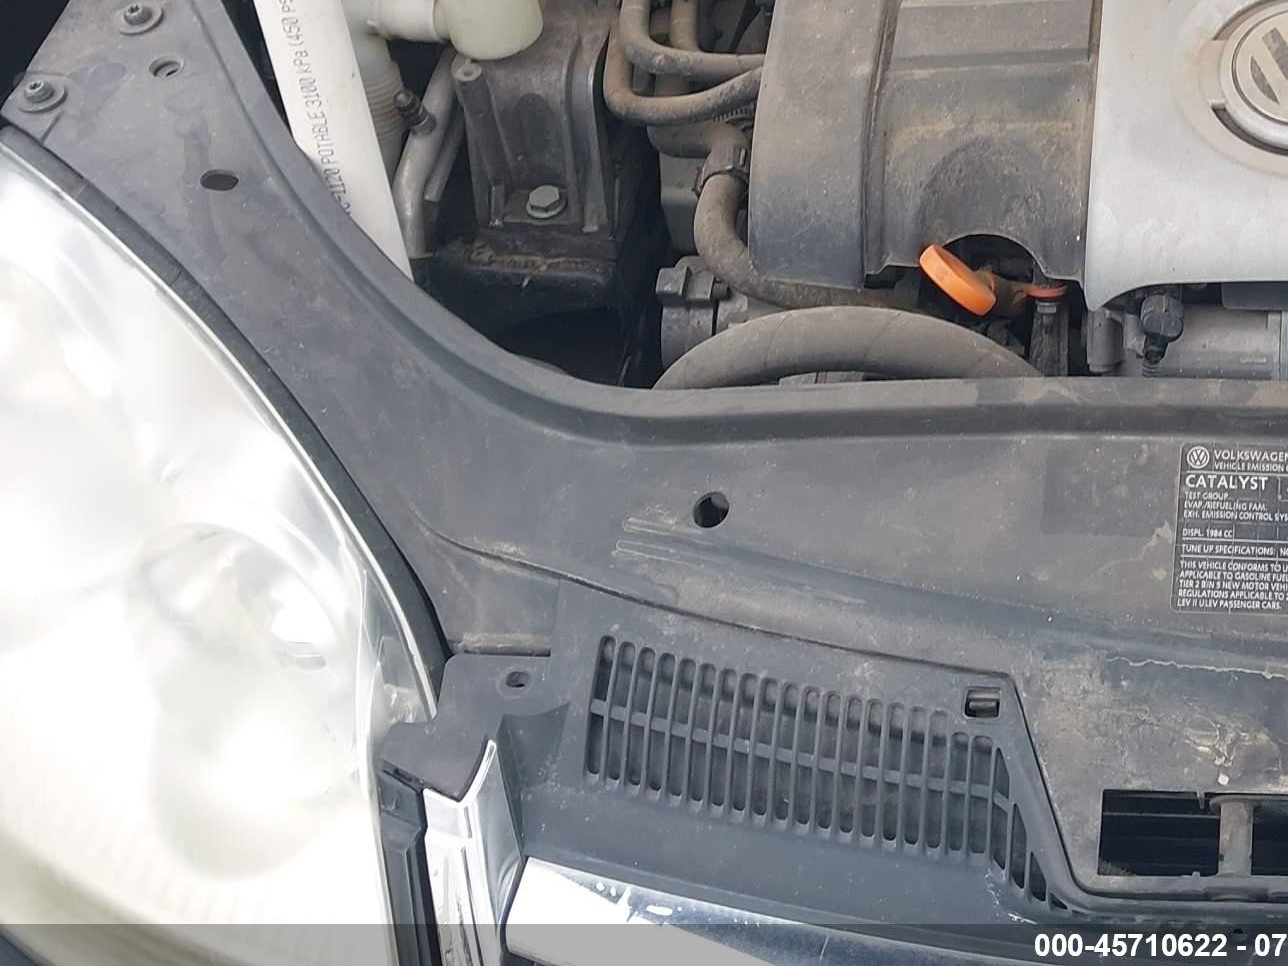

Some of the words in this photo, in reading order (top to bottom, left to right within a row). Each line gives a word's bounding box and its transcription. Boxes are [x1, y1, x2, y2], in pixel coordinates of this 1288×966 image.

[281, 16, 303, 46] (450
[299, 77, 321, 107] 3100
[307, 111, 335, 168] POTABLE
[1214, 463, 1246, 471] VEHICLE
[1247, 464, 1284, 472] EMISSION
[1185, 475, 1268, 490] CATALYST
[1185, 491, 1201, 499] TEST
[1203, 492, 1228, 500] GROUP
[1202, 511, 1237, 519] EMISSION
[1239, 512, 1273, 520] CONTROL
[1224, 529, 1233, 538] CC
[1181, 544, 1201, 553] TUNE
[1203, 545, 1213, 553] UP
[1198, 561, 1226, 570] VEHICLE
[1228, 562, 1268, 571] CONFORMS
[1270, 564, 1281, 572] TO
[1180, 571, 1220, 580] APPLICABLE
[1222, 572, 1233, 580] TO
[1235, 572, 1271, 581] GASOLINE
[1180, 580, 1193, 588] TIER
[1202, 581, 1215, 589] BIN
[1222, 582, 1239, 590] NEW
[1241, 582, 1269, 591] MOTOR
[1178, 590, 1228, 599] REGULATIONS
[1230, 591, 1272, 600] APPLICABLE
[1274, 592, 1284, 600] TO
[1177, 599, 1190, 607] LEV
[1199, 599, 1217, 608] ULEV
[1219, 600, 1261, 609] PASSENGER
